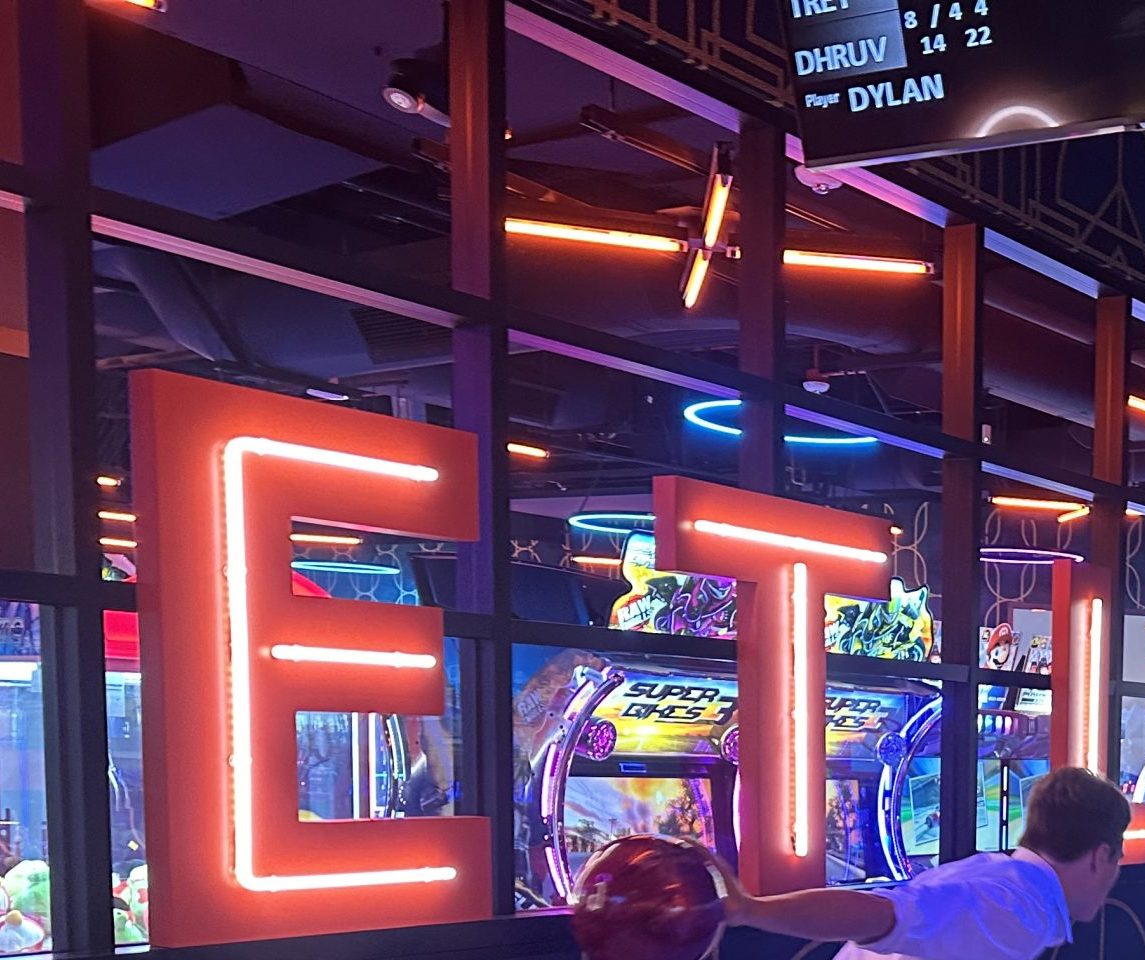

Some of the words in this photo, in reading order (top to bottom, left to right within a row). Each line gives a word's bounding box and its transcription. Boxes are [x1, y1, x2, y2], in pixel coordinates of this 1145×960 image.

[904, 11, 918, 29] 8
[948, 2, 962, 21] 4
[974, 0, 988, 16] 4
[920, 33, 947, 55] 14
[964, 26, 993, 48] 22
[794, 36, 887, 76] DHRUV
[804, 92, 840, 109] Player
[847, 73, 945, 112] DYLAN
[622, 682, 720, 703] SUPER
[622, 702, 706, 721] BIKES
